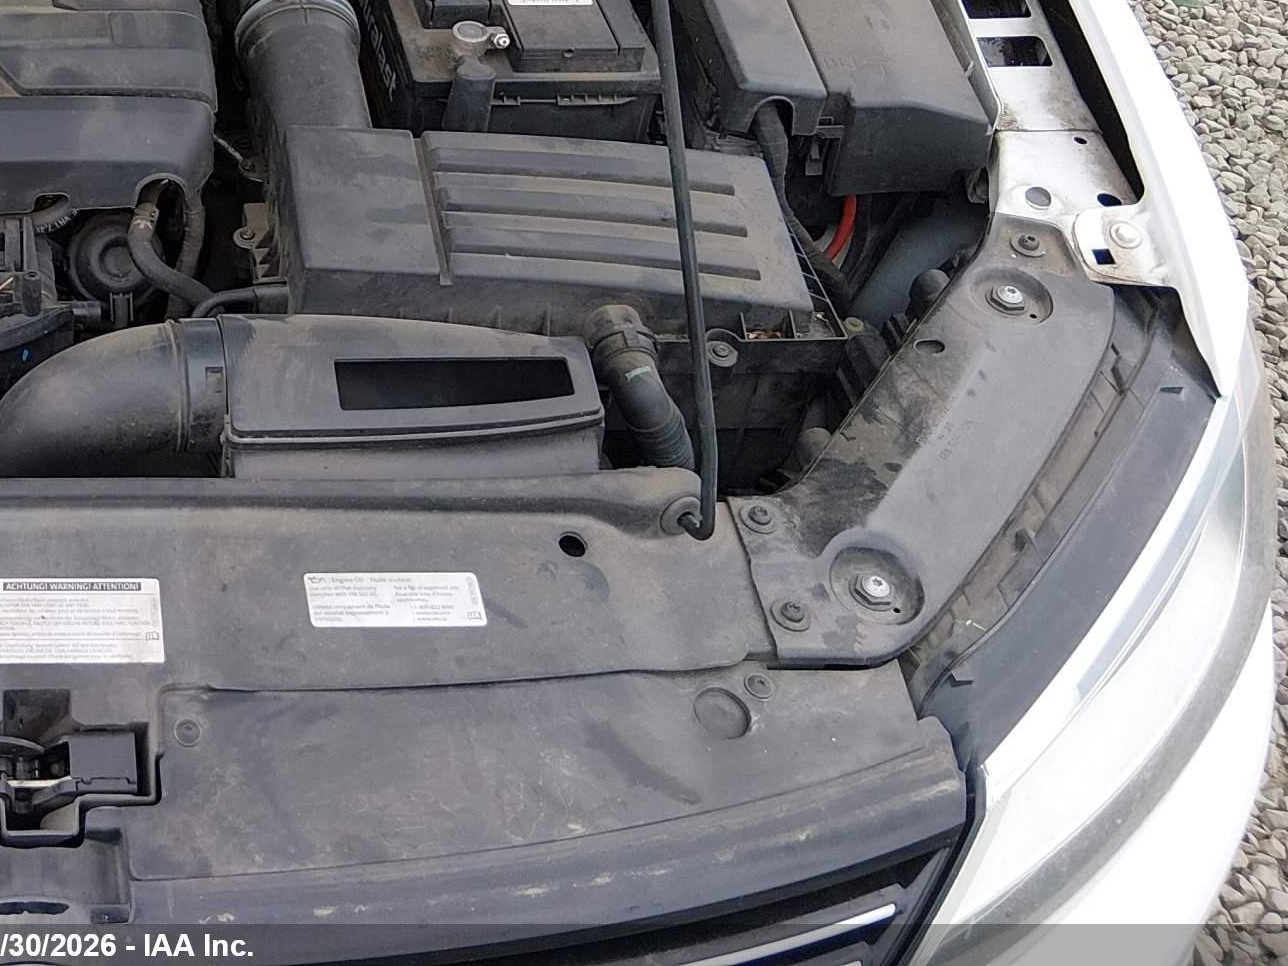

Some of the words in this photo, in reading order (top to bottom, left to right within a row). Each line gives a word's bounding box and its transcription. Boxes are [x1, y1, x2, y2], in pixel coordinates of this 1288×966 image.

[6, 582, 48, 591] ACHTUNG!
[50, 582, 91, 591] WARNING!
[93, 582, 139, 591] ATTENTION!
